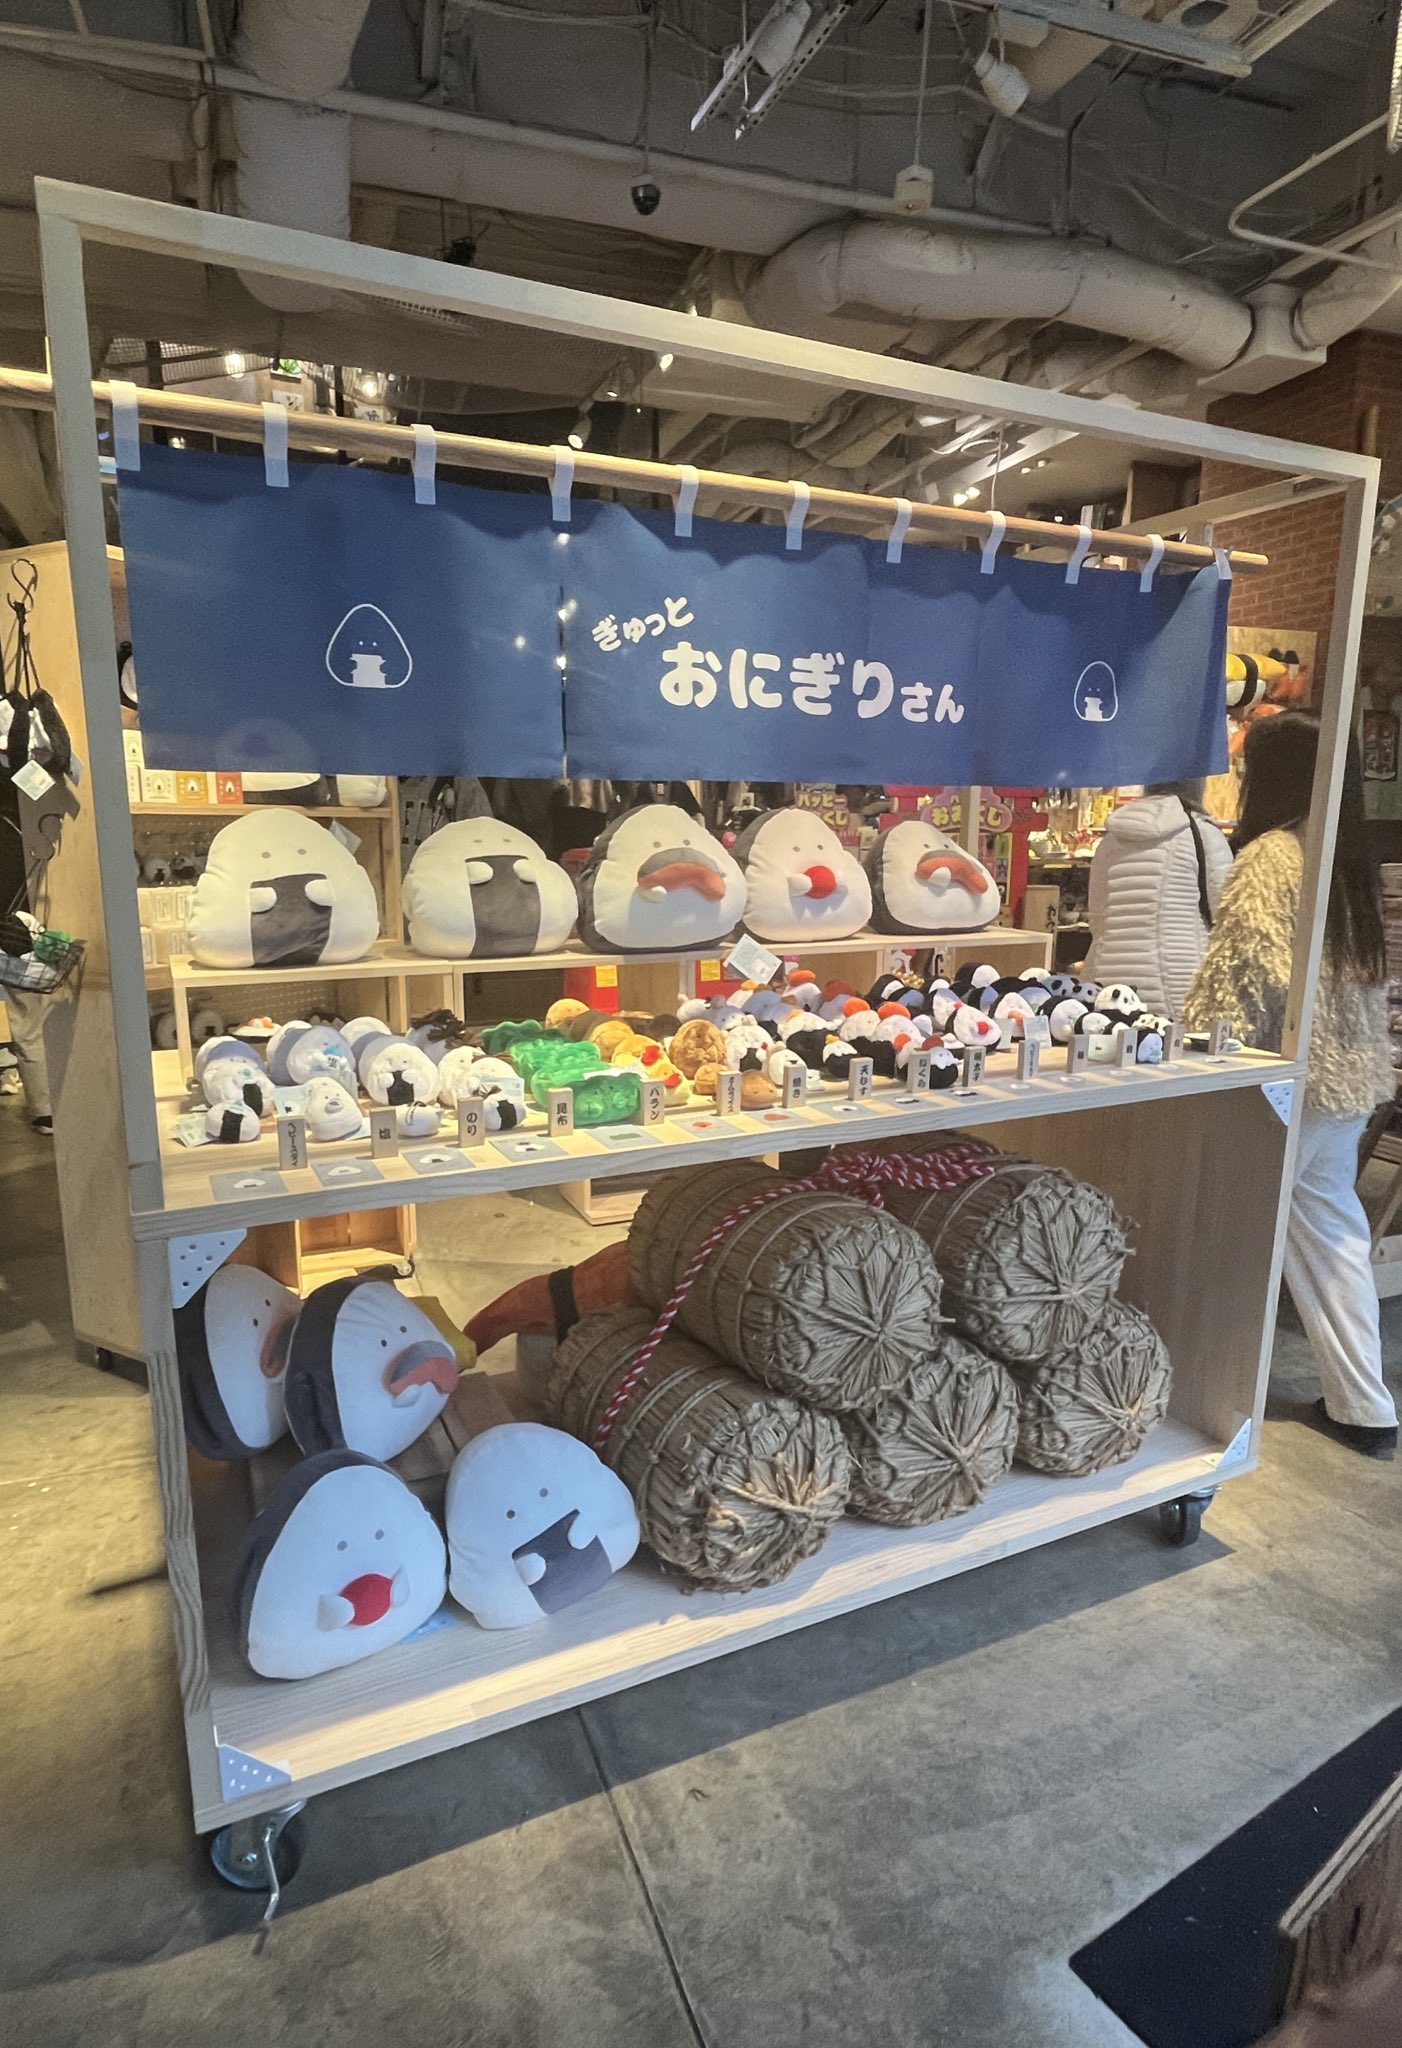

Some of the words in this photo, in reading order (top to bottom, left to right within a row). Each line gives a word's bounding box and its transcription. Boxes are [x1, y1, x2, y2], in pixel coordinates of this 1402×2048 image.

[591, 597, 694, 652] ぎゅっと
[659, 641, 965, 723] おにぎりさん
[859, 1064, 870, 1096] 天むす
[466, 1112, 478, 1137] のり
[556, 1102, 569, 1126] 昆布
